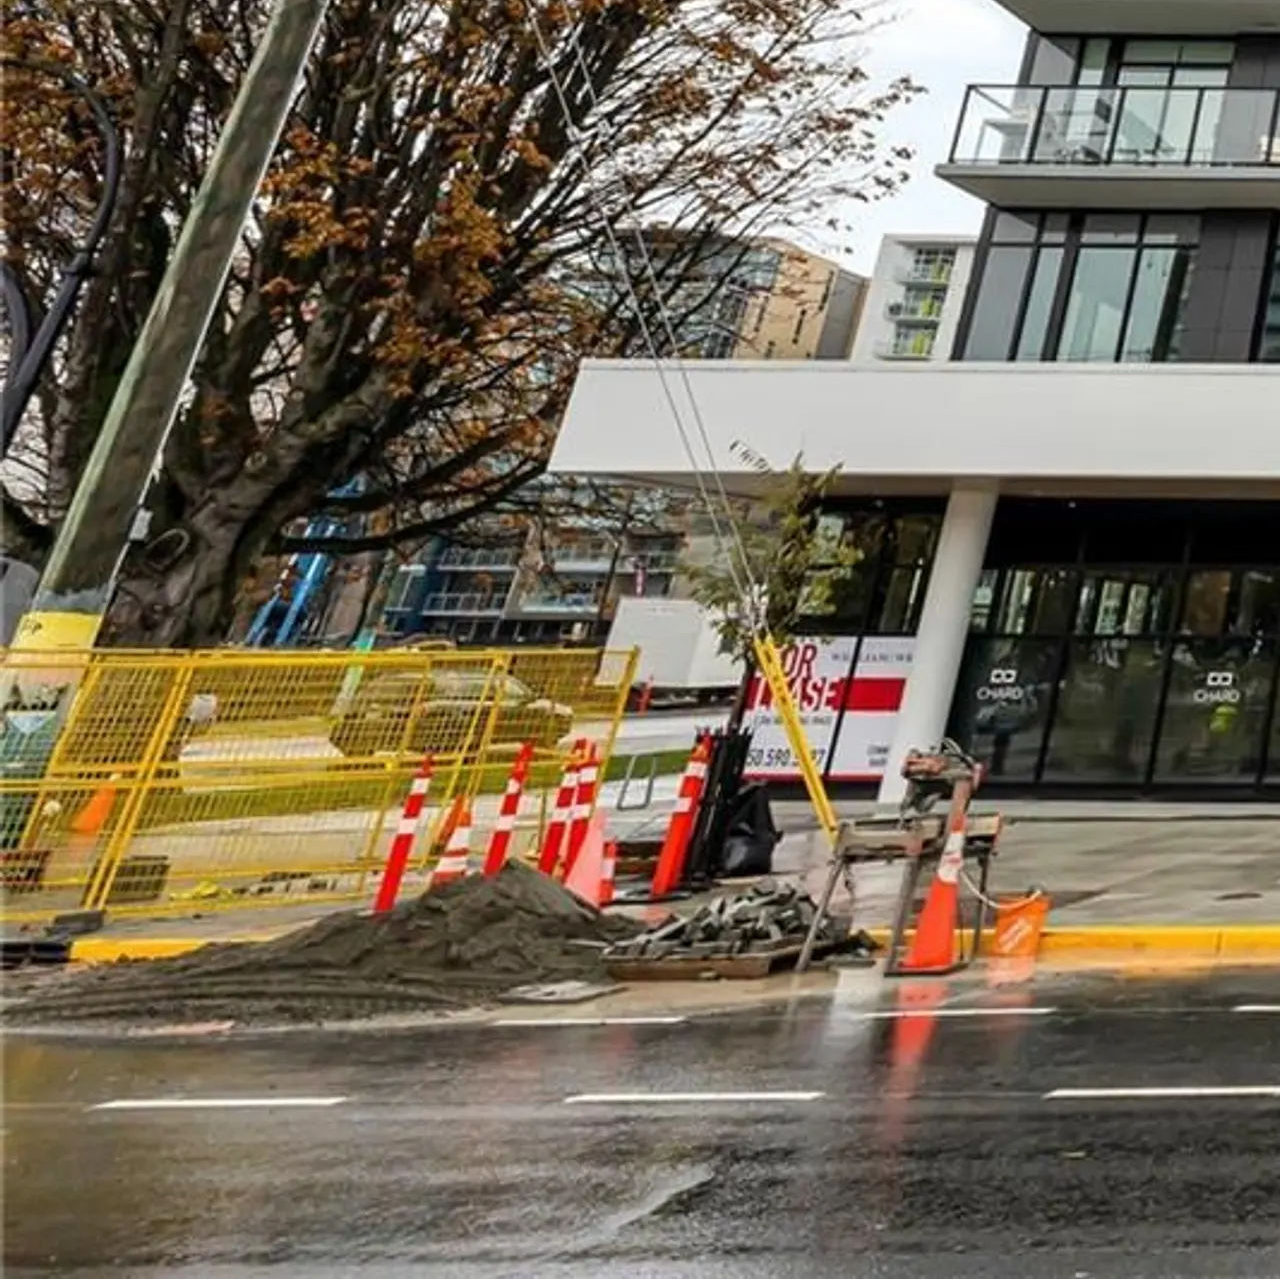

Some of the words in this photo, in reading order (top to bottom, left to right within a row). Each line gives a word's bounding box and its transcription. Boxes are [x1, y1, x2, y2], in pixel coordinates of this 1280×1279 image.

[778, 643, 818, 681] OR
[750, 675, 842, 712] LASE
[977, 686, 1024, 700] CHARD
[1193, 688, 1241, 703] CHARD
